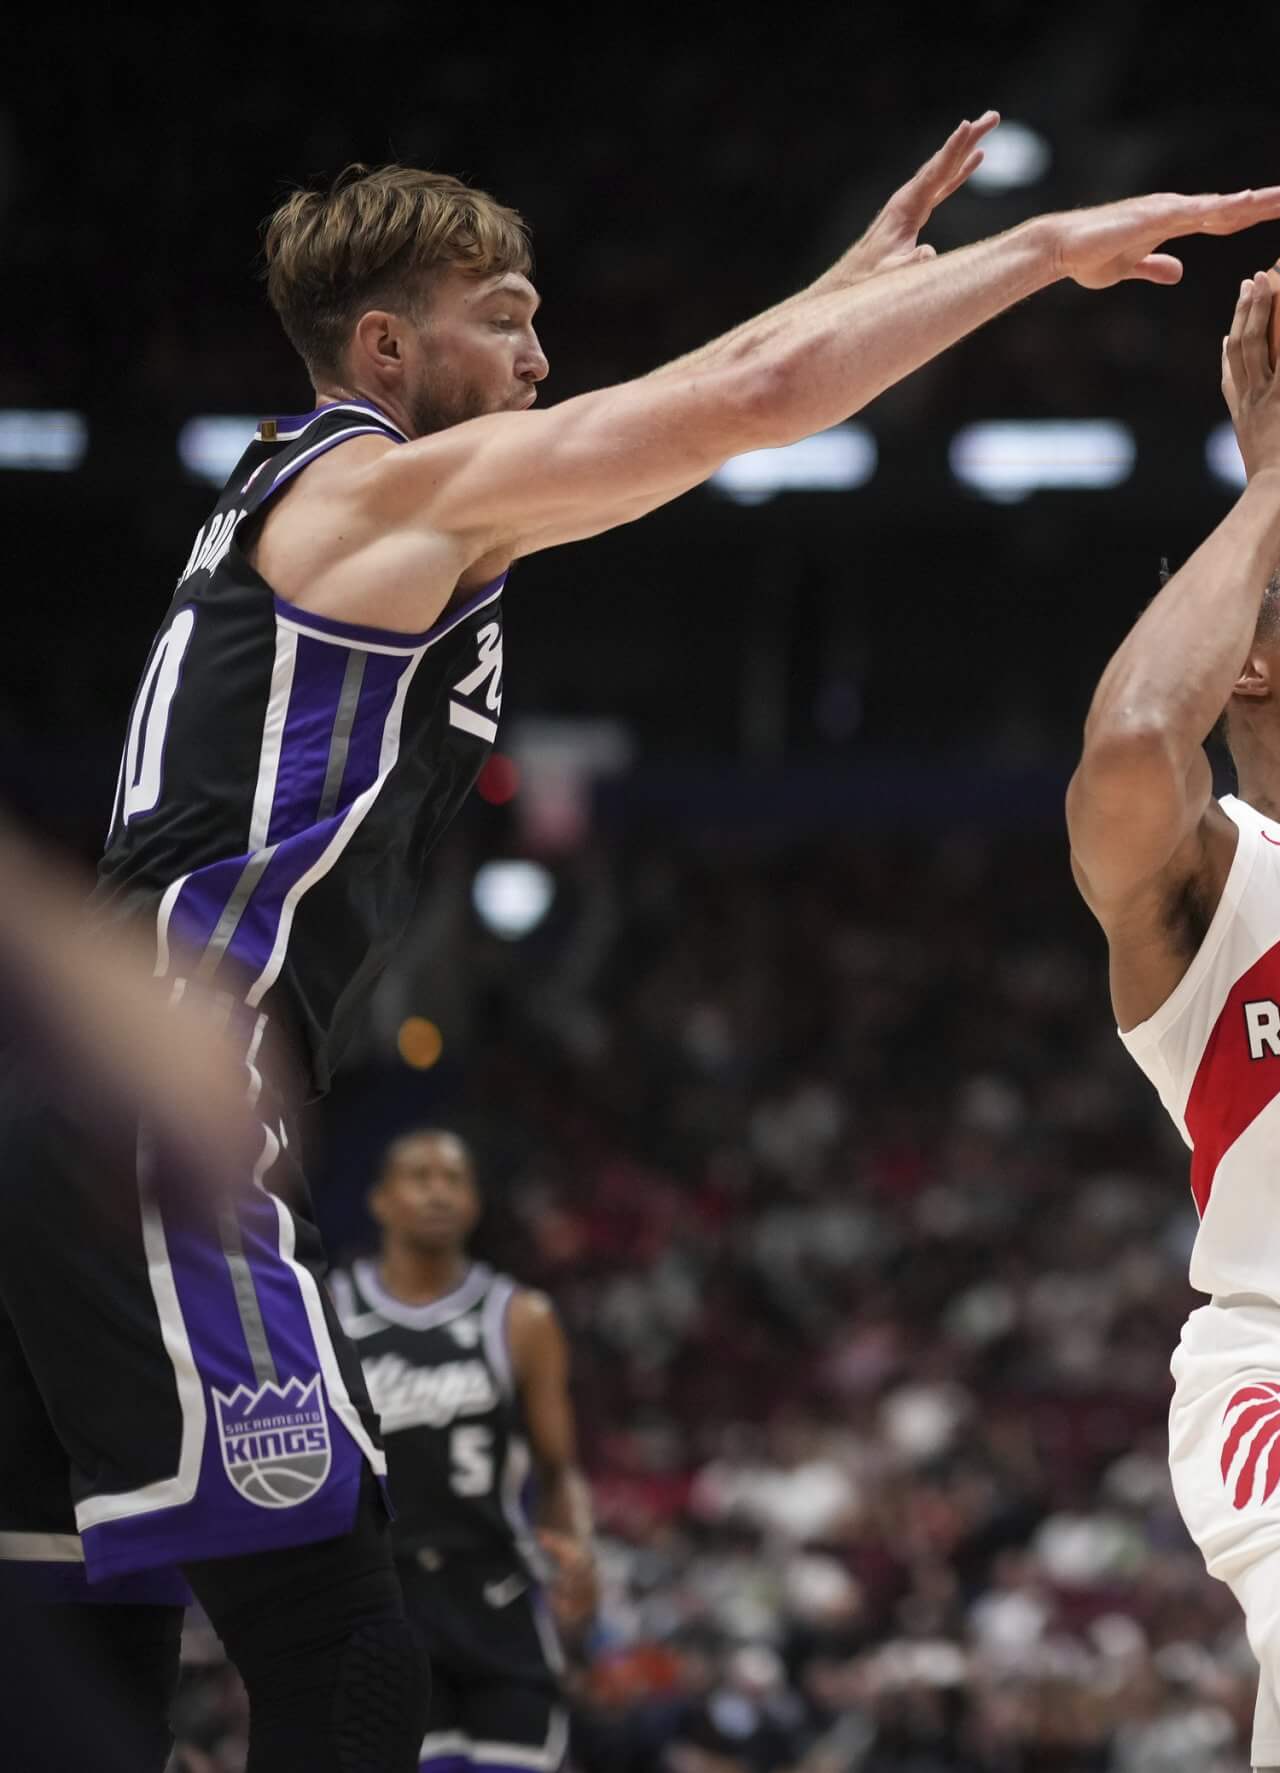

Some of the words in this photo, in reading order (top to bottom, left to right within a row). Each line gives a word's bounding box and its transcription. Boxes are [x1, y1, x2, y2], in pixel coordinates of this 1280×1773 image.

[225, 1411, 321, 1435] SACRAMENTO
[225, 1428, 327, 1465] KINGS
[450, 1424, 495, 1497] 5
